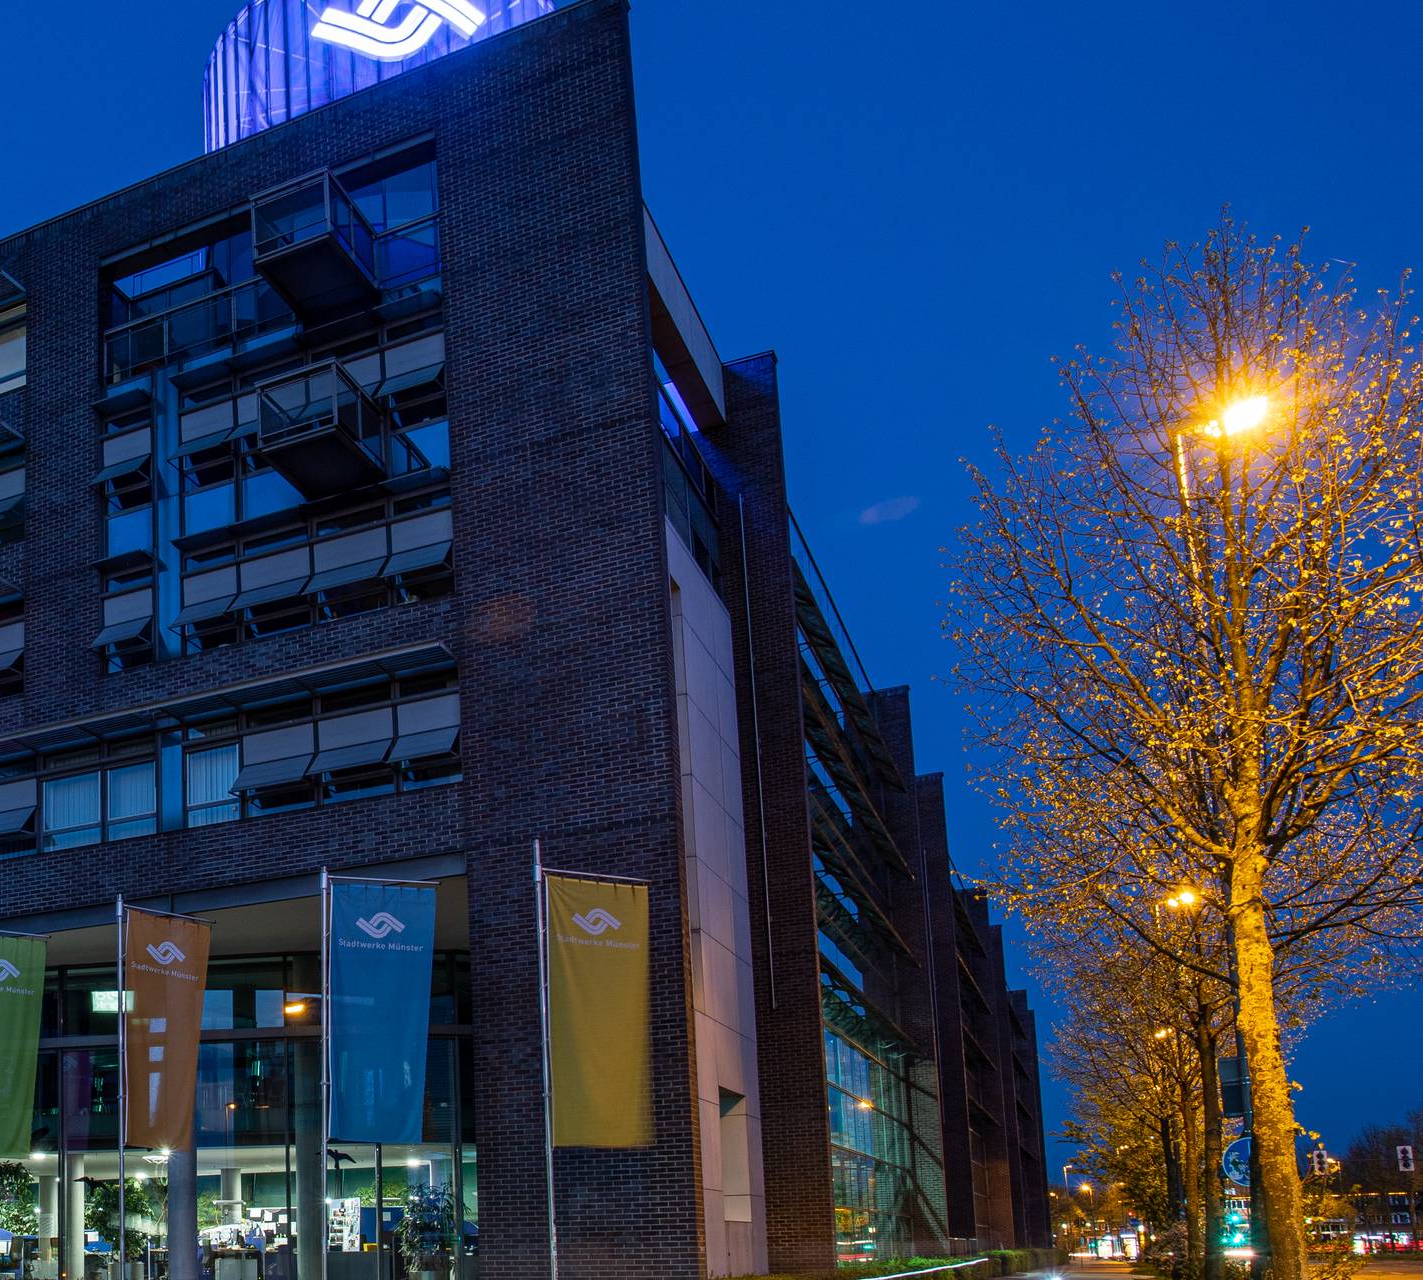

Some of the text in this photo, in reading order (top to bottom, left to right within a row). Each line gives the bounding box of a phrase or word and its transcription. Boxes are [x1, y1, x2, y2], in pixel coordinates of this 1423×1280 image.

[338, 938, 424, 952] Stadtwerke Münster
[130, 960, 199, 982] Stadtwerke Münster
[6, 984, 35, 996] Münster
